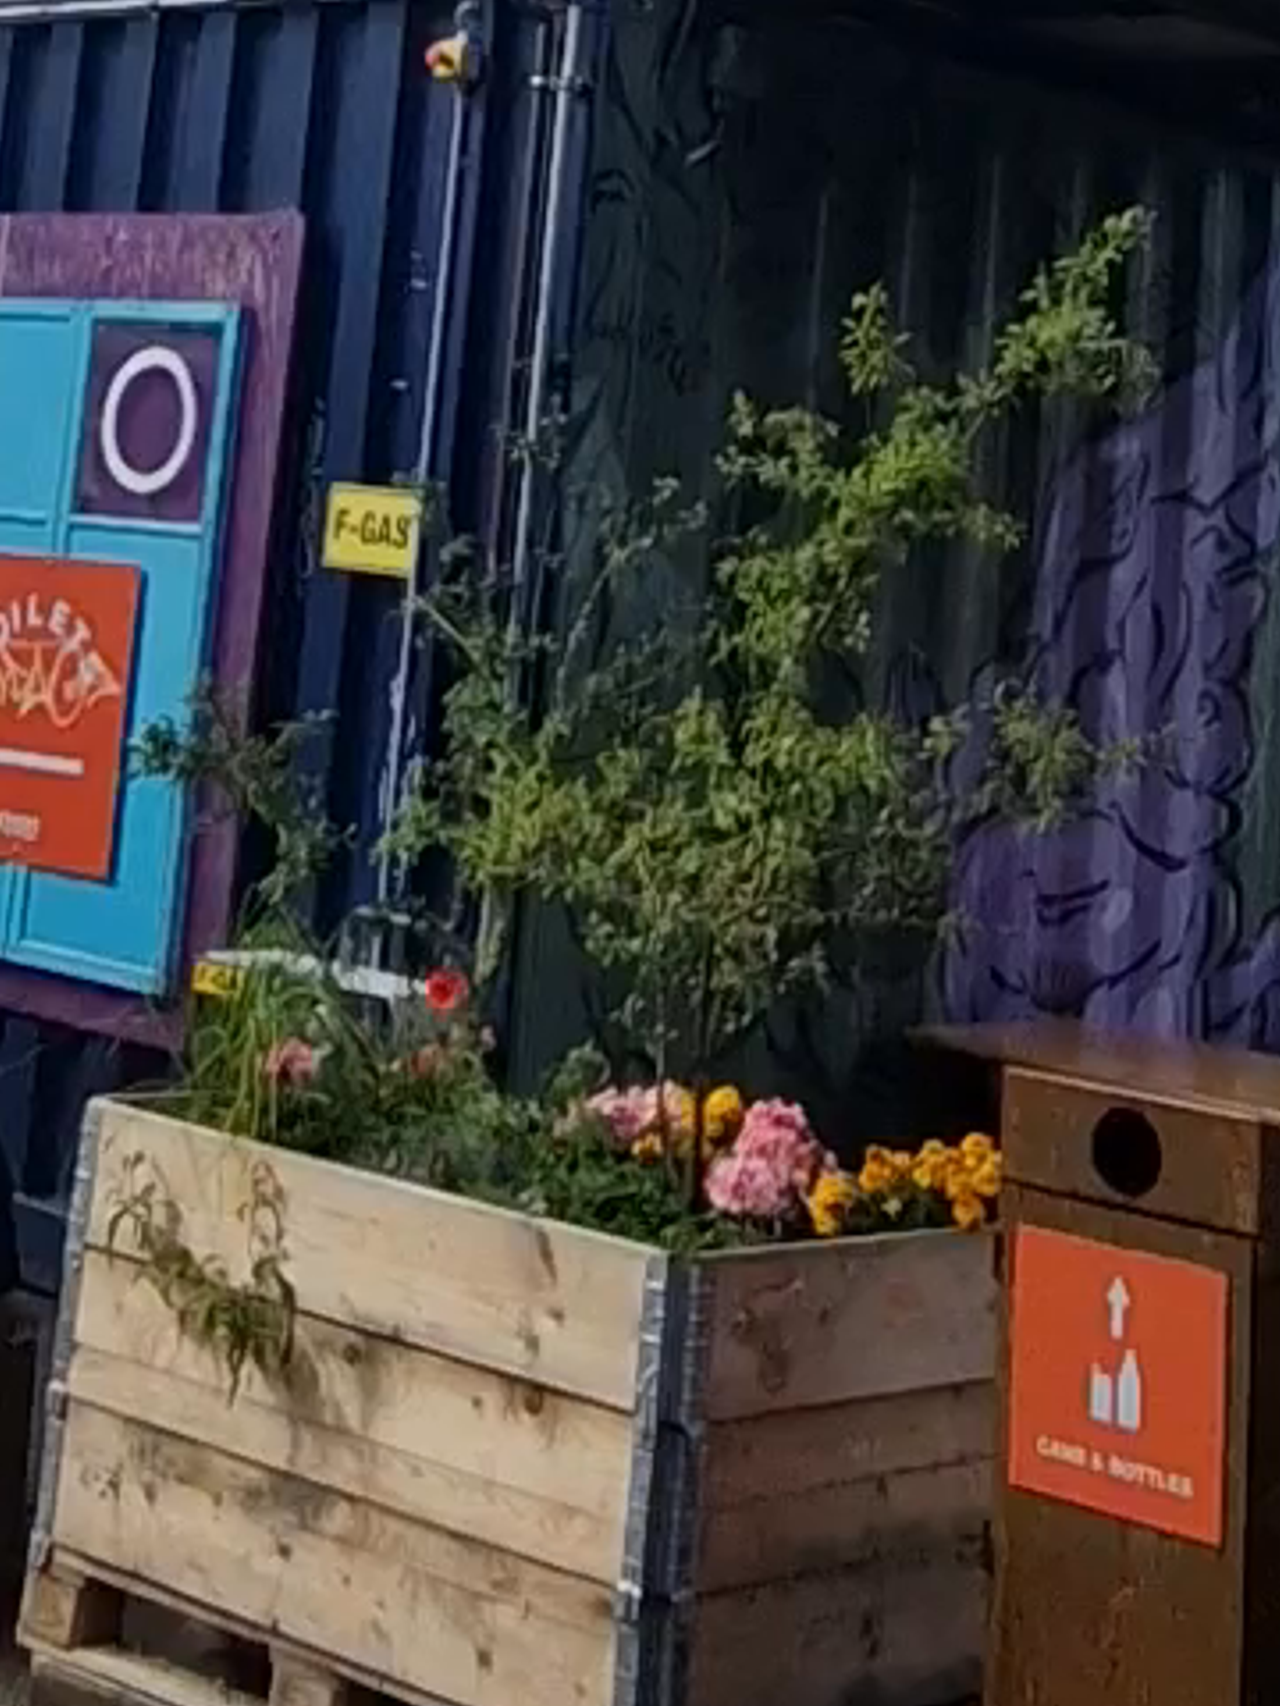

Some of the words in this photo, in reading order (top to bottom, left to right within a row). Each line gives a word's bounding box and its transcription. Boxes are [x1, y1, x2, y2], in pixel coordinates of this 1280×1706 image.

[333, 507, 412, 550] F-GAS
[1036, 1435, 1085, 1467] CANS
[1091, 1451, 1104, 1472] &
[1108, 1454, 1193, 1500] BOTTLES
